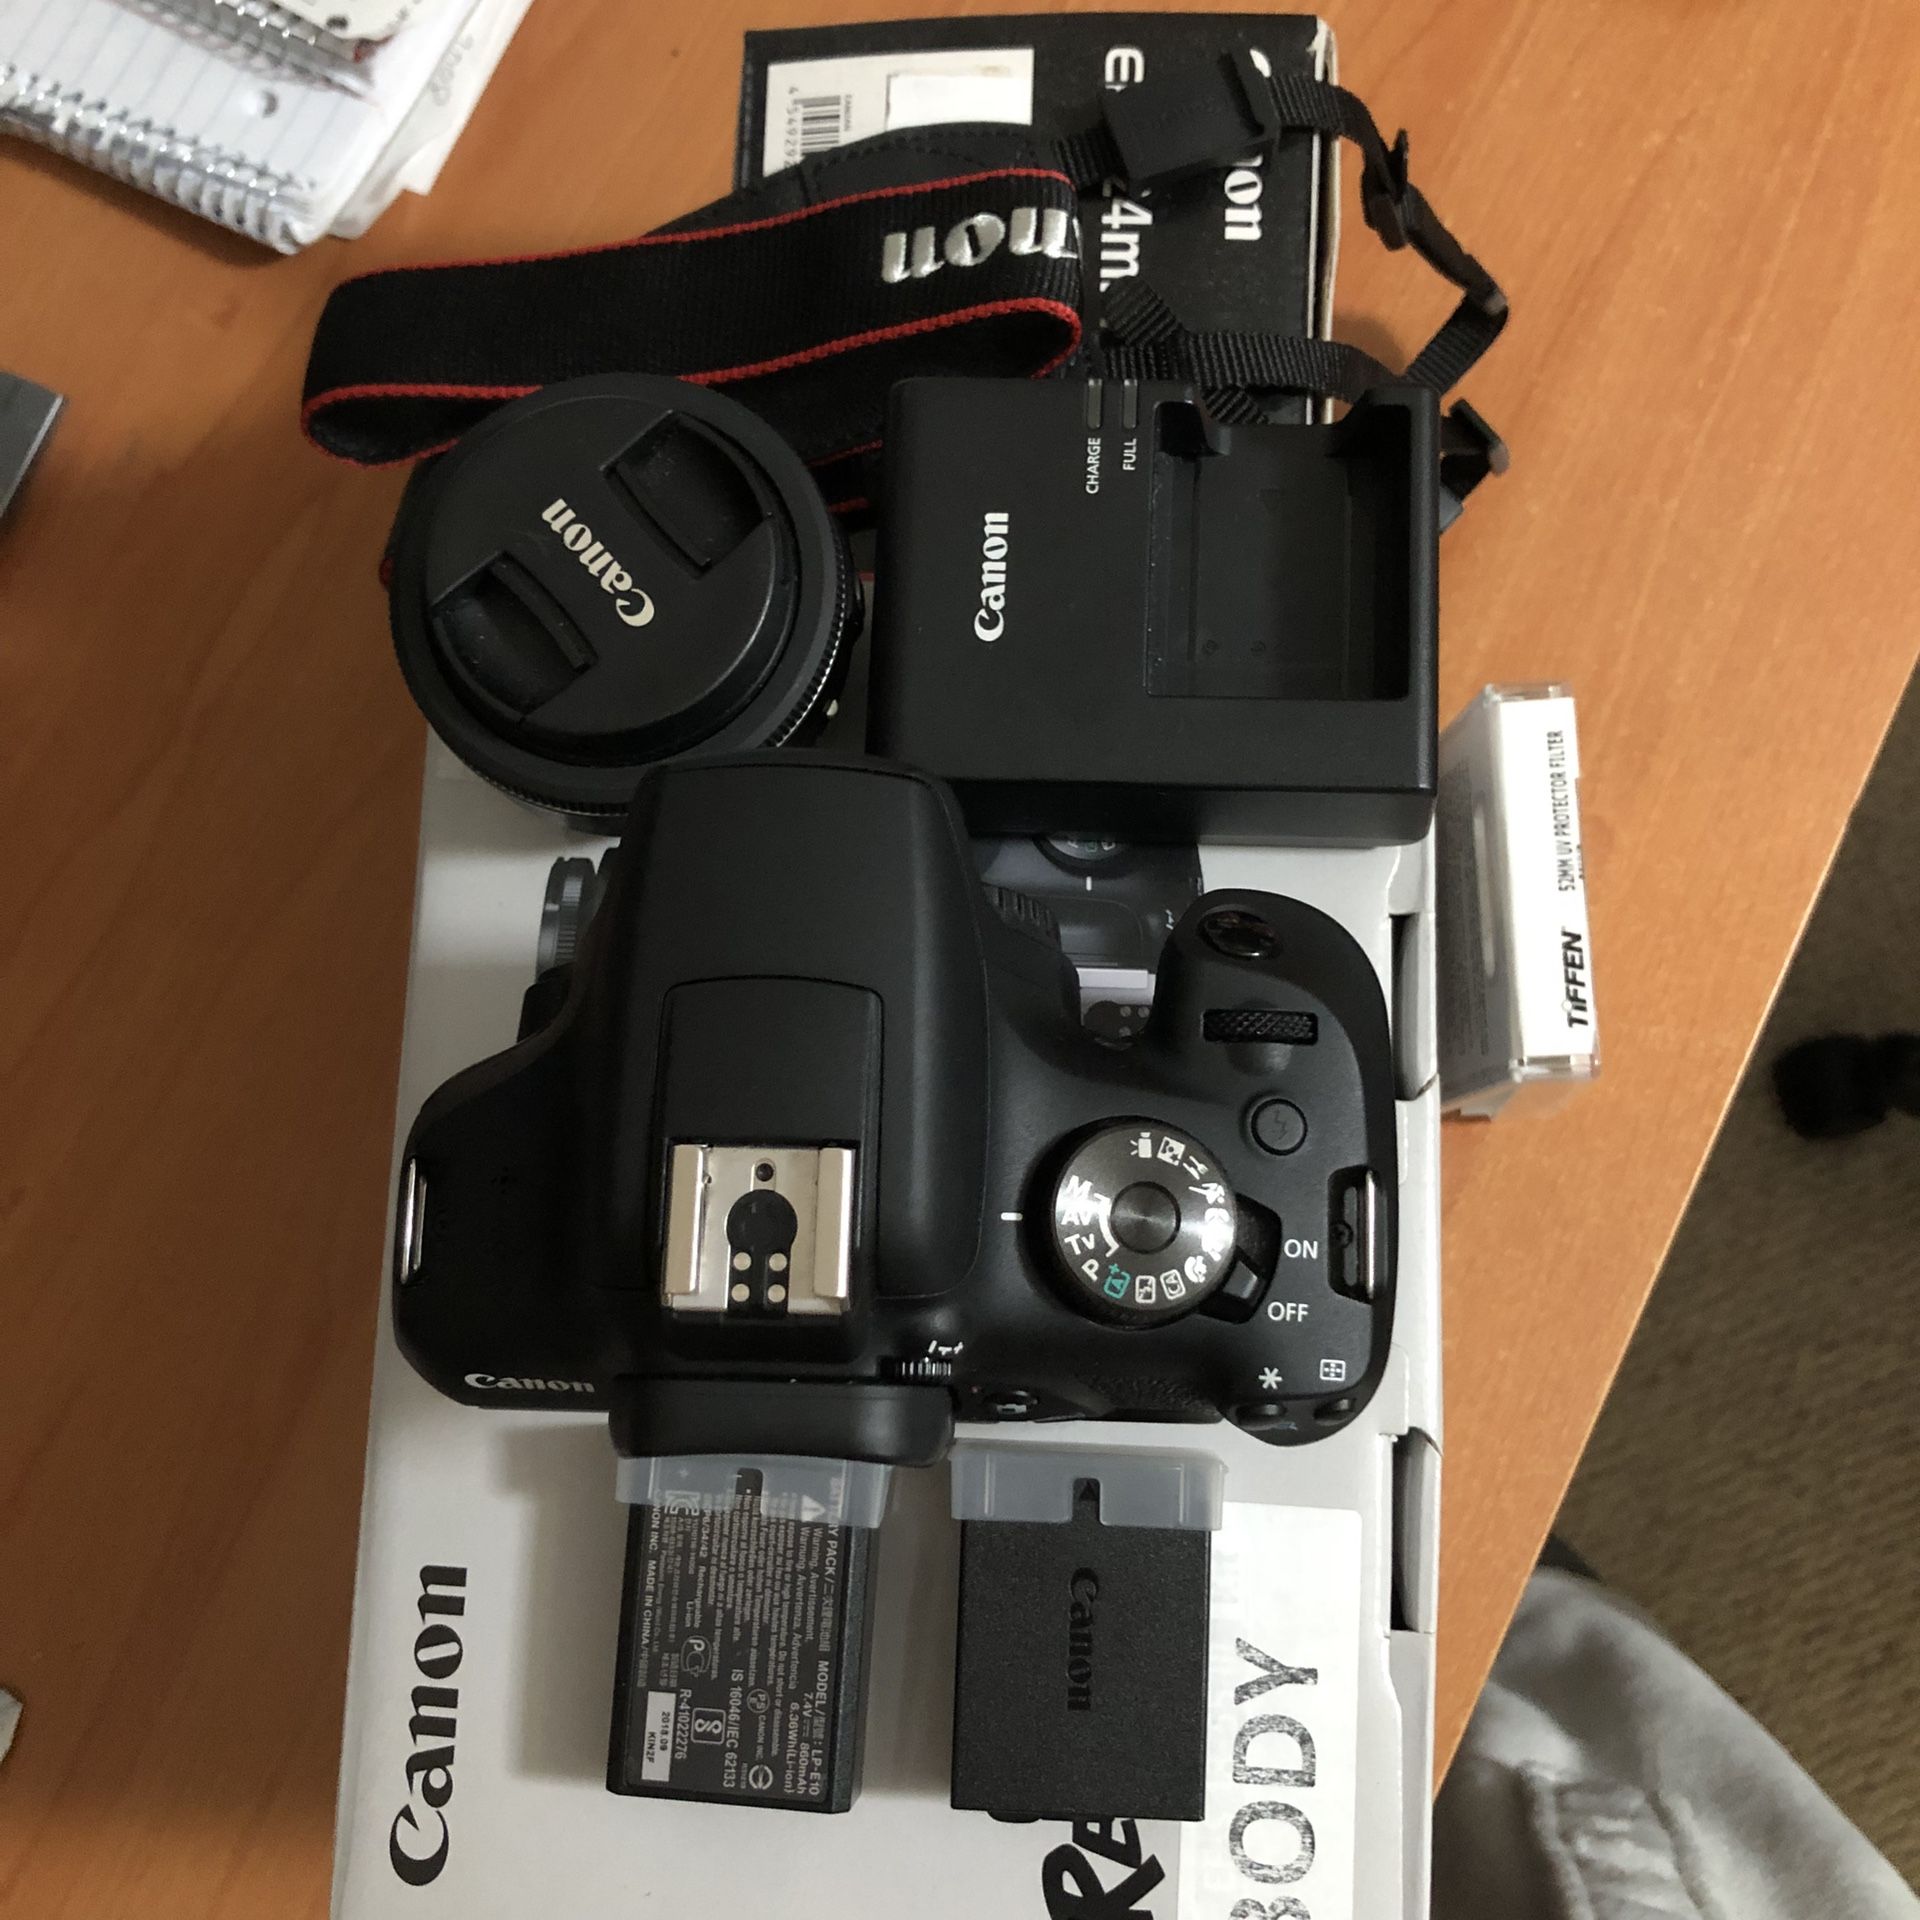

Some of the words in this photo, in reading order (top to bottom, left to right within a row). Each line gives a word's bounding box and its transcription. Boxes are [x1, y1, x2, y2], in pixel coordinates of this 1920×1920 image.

[881, 206, 1083, 284] non
[1085, 437, 1101, 495] CHARGE
[1122, 437, 1137, 472] FULL
[541, 497, 657, 628] Canon
[973, 512, 1010, 643] Canon
[1546, 729, 1566, 769] FILTER
[1549, 770, 1572, 838] PROTECTOR
[1555, 839, 1573, 856] UV
[1555, 858, 1577, 892] 52MM
[1283, 1239, 1319, 1260] ON
[1081, 1258, 1100, 1283] P
[1266, 1301, 1309, 1323] OFF
[463, 1372, 595, 1394] Canon
[645, 1560, 657, 1592] MADE
[644, 1594, 653, 1606] IN
[1066, 1566, 1099, 1712] Canon
[730, 1669, 743, 1681] IS
[725, 1685, 741, 1748] 16046/IEC
[801, 1692, 812, 1717] 7.4V
[389, 1564, 468, 1886] Canon
[674, 1688, 691, 1759] R-41022276
[722, 1751, 736, 1788] 62133
[808, 1749, 821, 1795] LP-E10
